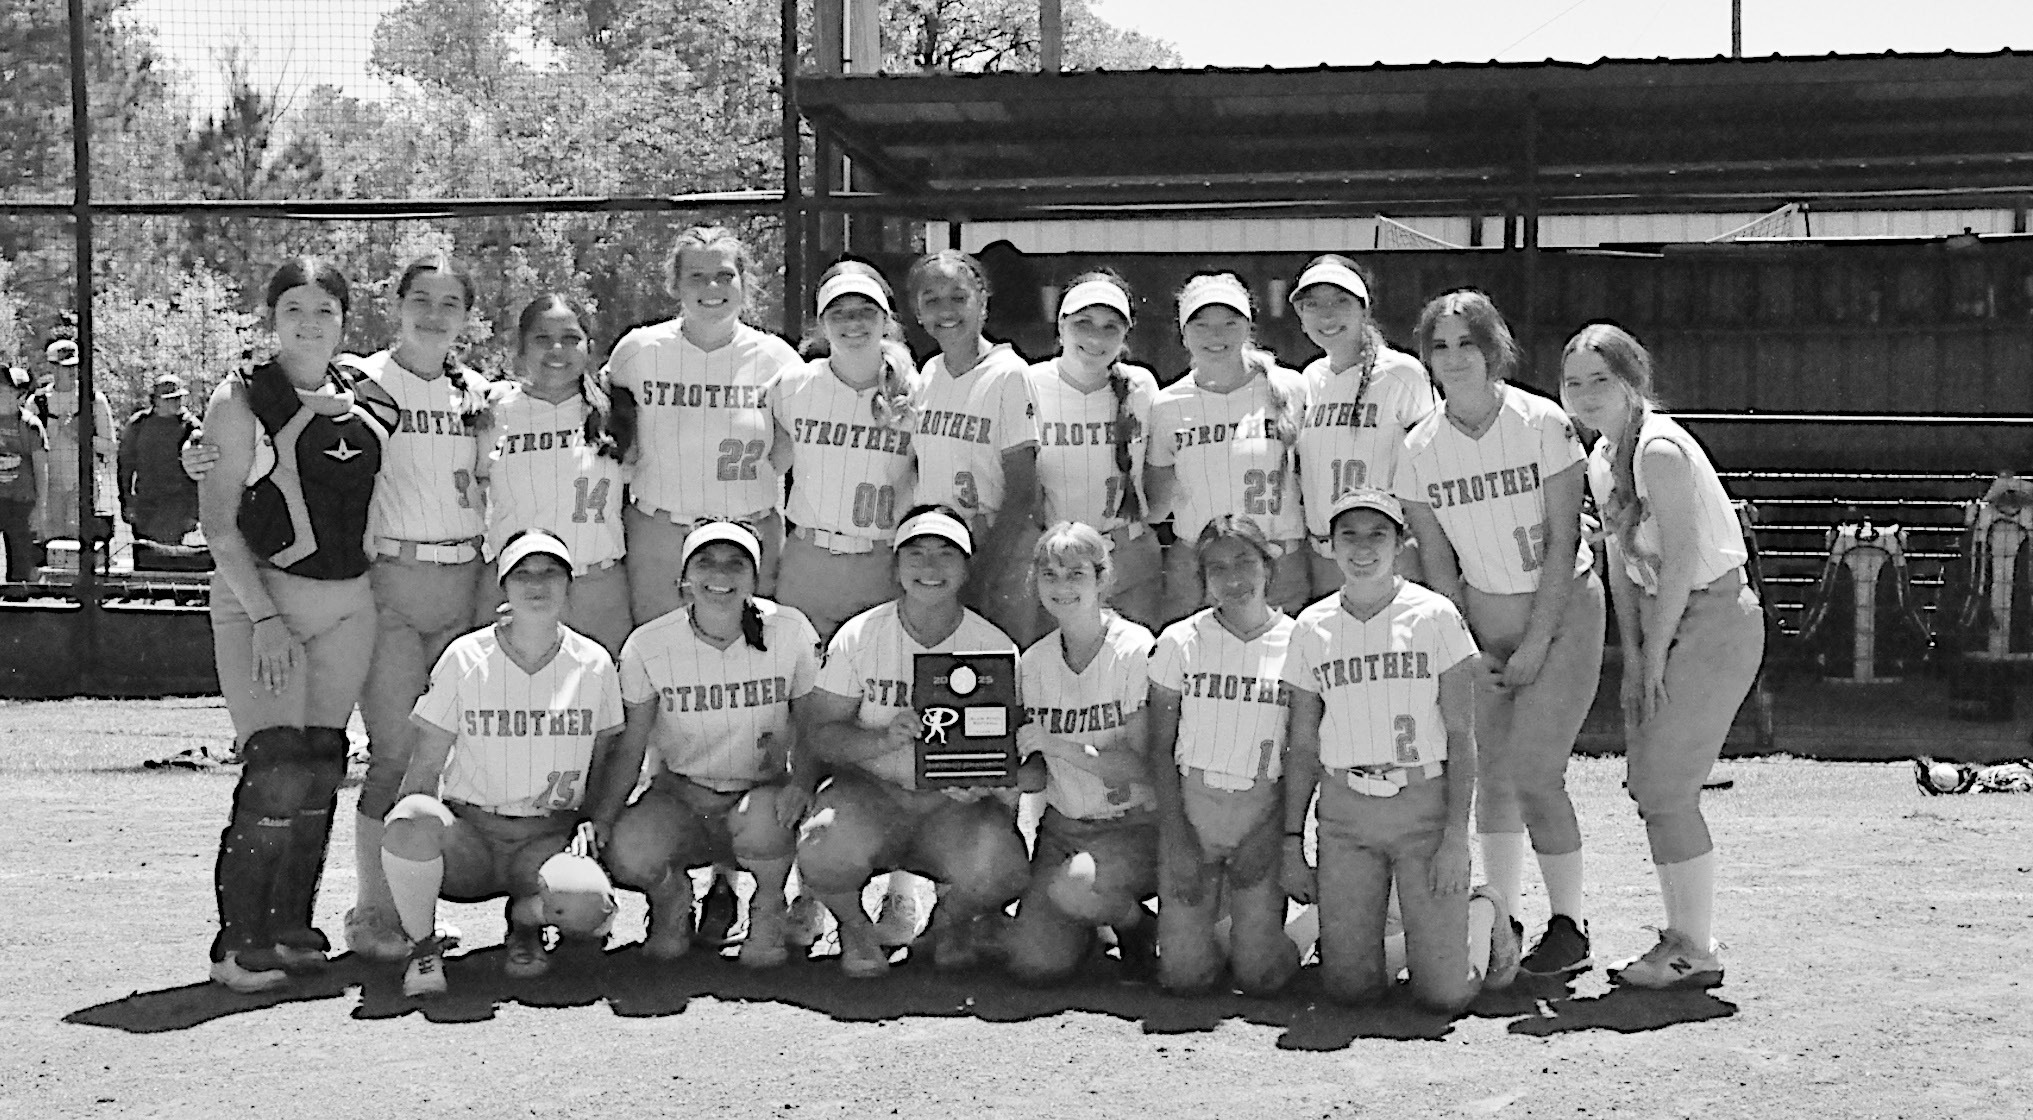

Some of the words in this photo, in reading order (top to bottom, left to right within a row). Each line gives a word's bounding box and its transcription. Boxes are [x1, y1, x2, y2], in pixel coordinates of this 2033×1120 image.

[643, 380, 768, 408] STROTHER
[400, 409, 479, 437] ROTH
[794, 417, 912, 455] STROTHER
[915, 409, 991, 444] ROTHER
[717, 438, 766, 481] 22
[572, 477, 611, 523] 14
[954, 471, 979, 509] 3
[1102, 476, 1121, 518] 1
[1243, 469, 1282, 515] 23
[1331, 459, 1367, 505] 10
[852, 482, 896, 530] 00
[933, 675, 948, 685] 20
[978, 675, 994, 685] 25
[1183, 673, 1291, 707] STROTHE
[1312, 651, 1431, 693] STROTHER
[662, 676, 788, 712] STROTHER
[465, 709, 593, 737] STROTHER
[1394, 714, 1420, 763] 2
[533, 770, 581, 807] 15
[1669, 957, 1692, 975] N
